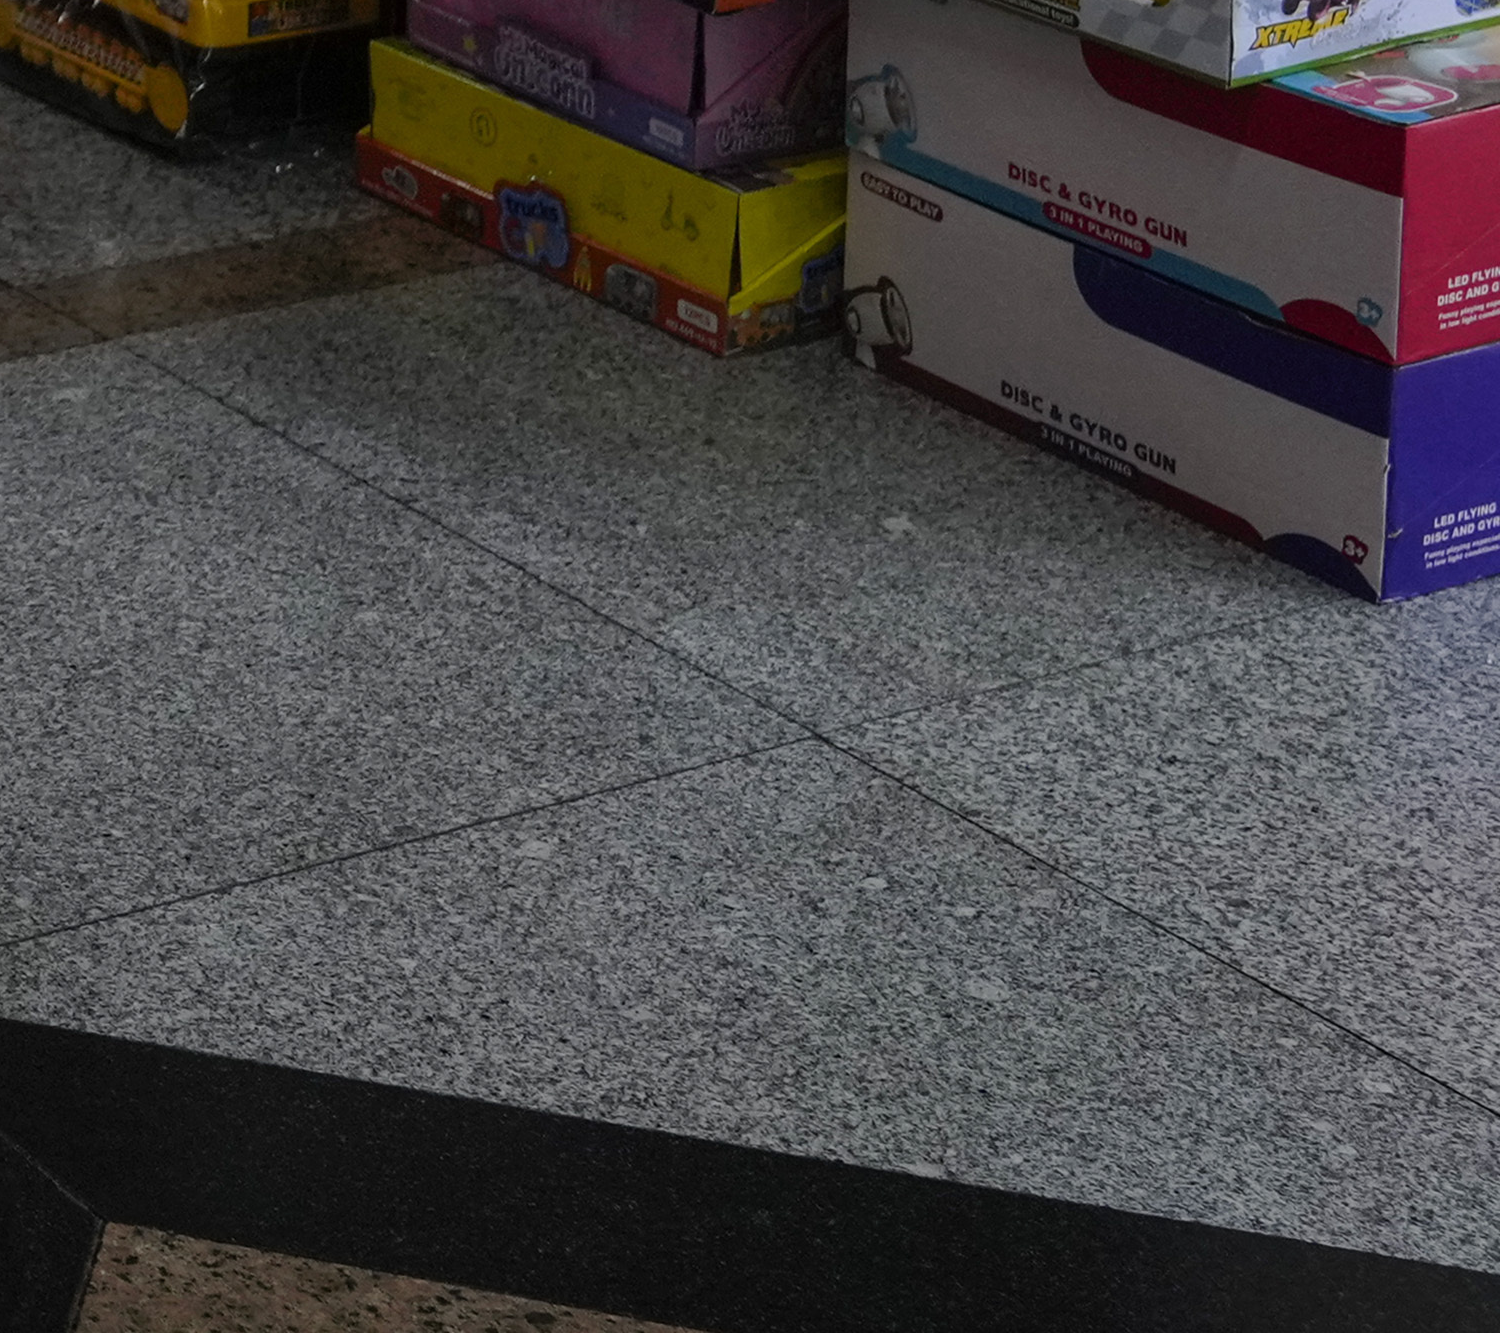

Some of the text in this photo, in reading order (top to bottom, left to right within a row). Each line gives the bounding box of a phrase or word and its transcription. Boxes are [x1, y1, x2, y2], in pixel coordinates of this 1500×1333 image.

[504, 196, 560, 225] trucks
[909, 196, 941, 221] PLAY
[1007, 160, 1188, 248] DISC & GYRO GUN
[1059, 209, 1075, 225] IN
[1087, 218, 1145, 254] PLAYING
[1437, 289, 1464, 307] DISC
[1465, 284, 1490, 302] AND
[1448, 274, 1470, 290] LED
[1001, 379, 1177, 475] DISC & GYRO GUN
[1051, 430, 1065, 446] IN
[1078, 443, 1133, 478] PLAYING
[1433, 501, 1498, 530] LED FLYING
[1423, 528, 1450, 547] DISC
[1450, 523, 1476, 542] AND
